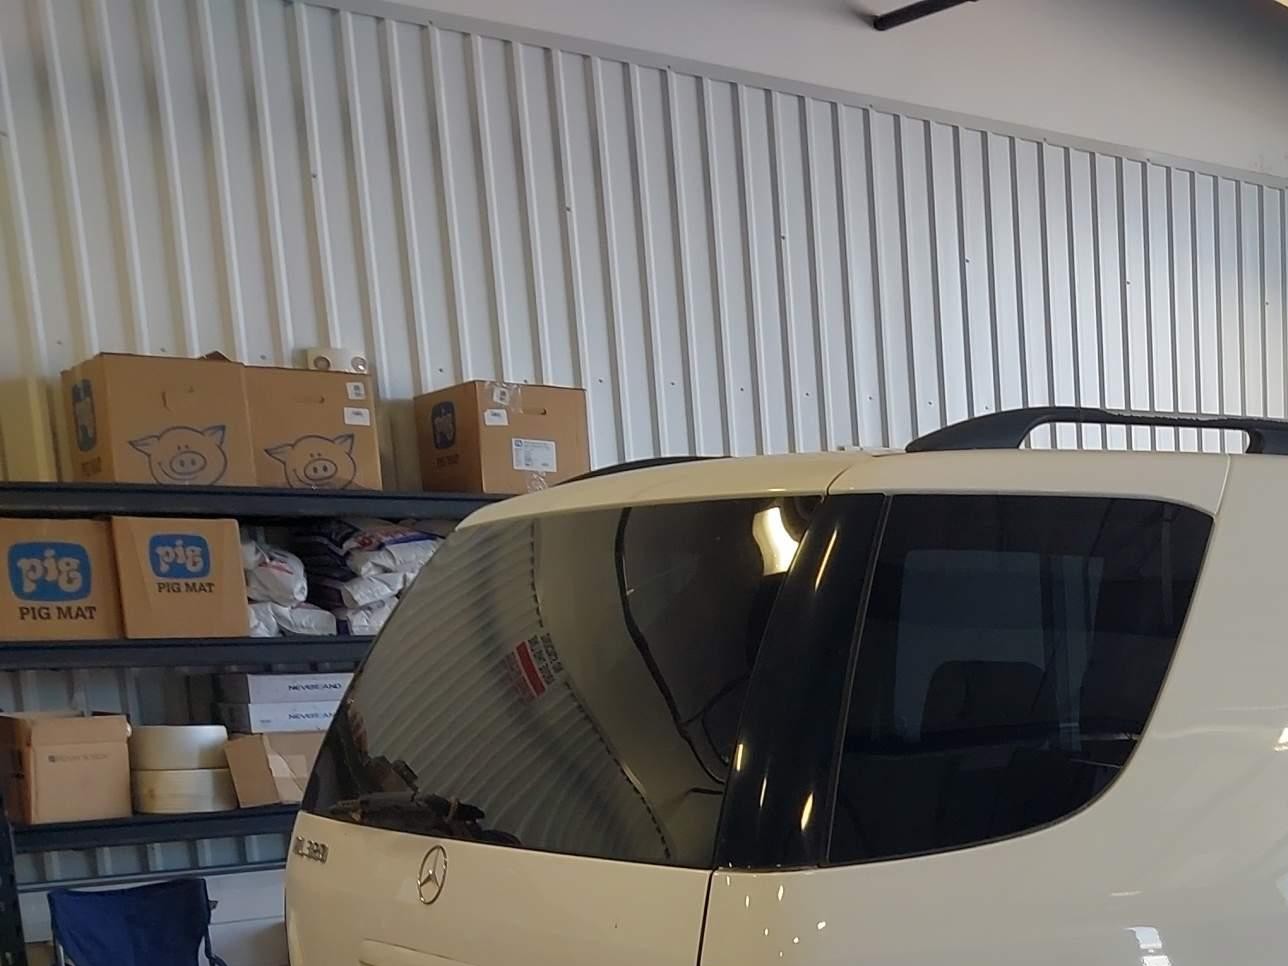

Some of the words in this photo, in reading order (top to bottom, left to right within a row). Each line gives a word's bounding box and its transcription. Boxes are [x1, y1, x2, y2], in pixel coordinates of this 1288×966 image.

[155, 539, 203, 573] pig
[17, 549, 82, 593] pig
[157, 582, 181, 593] PIG
[185, 582, 215, 593] MAT
[19, 607, 51, 620] PIG
[57, 606, 97, 620] MAT
